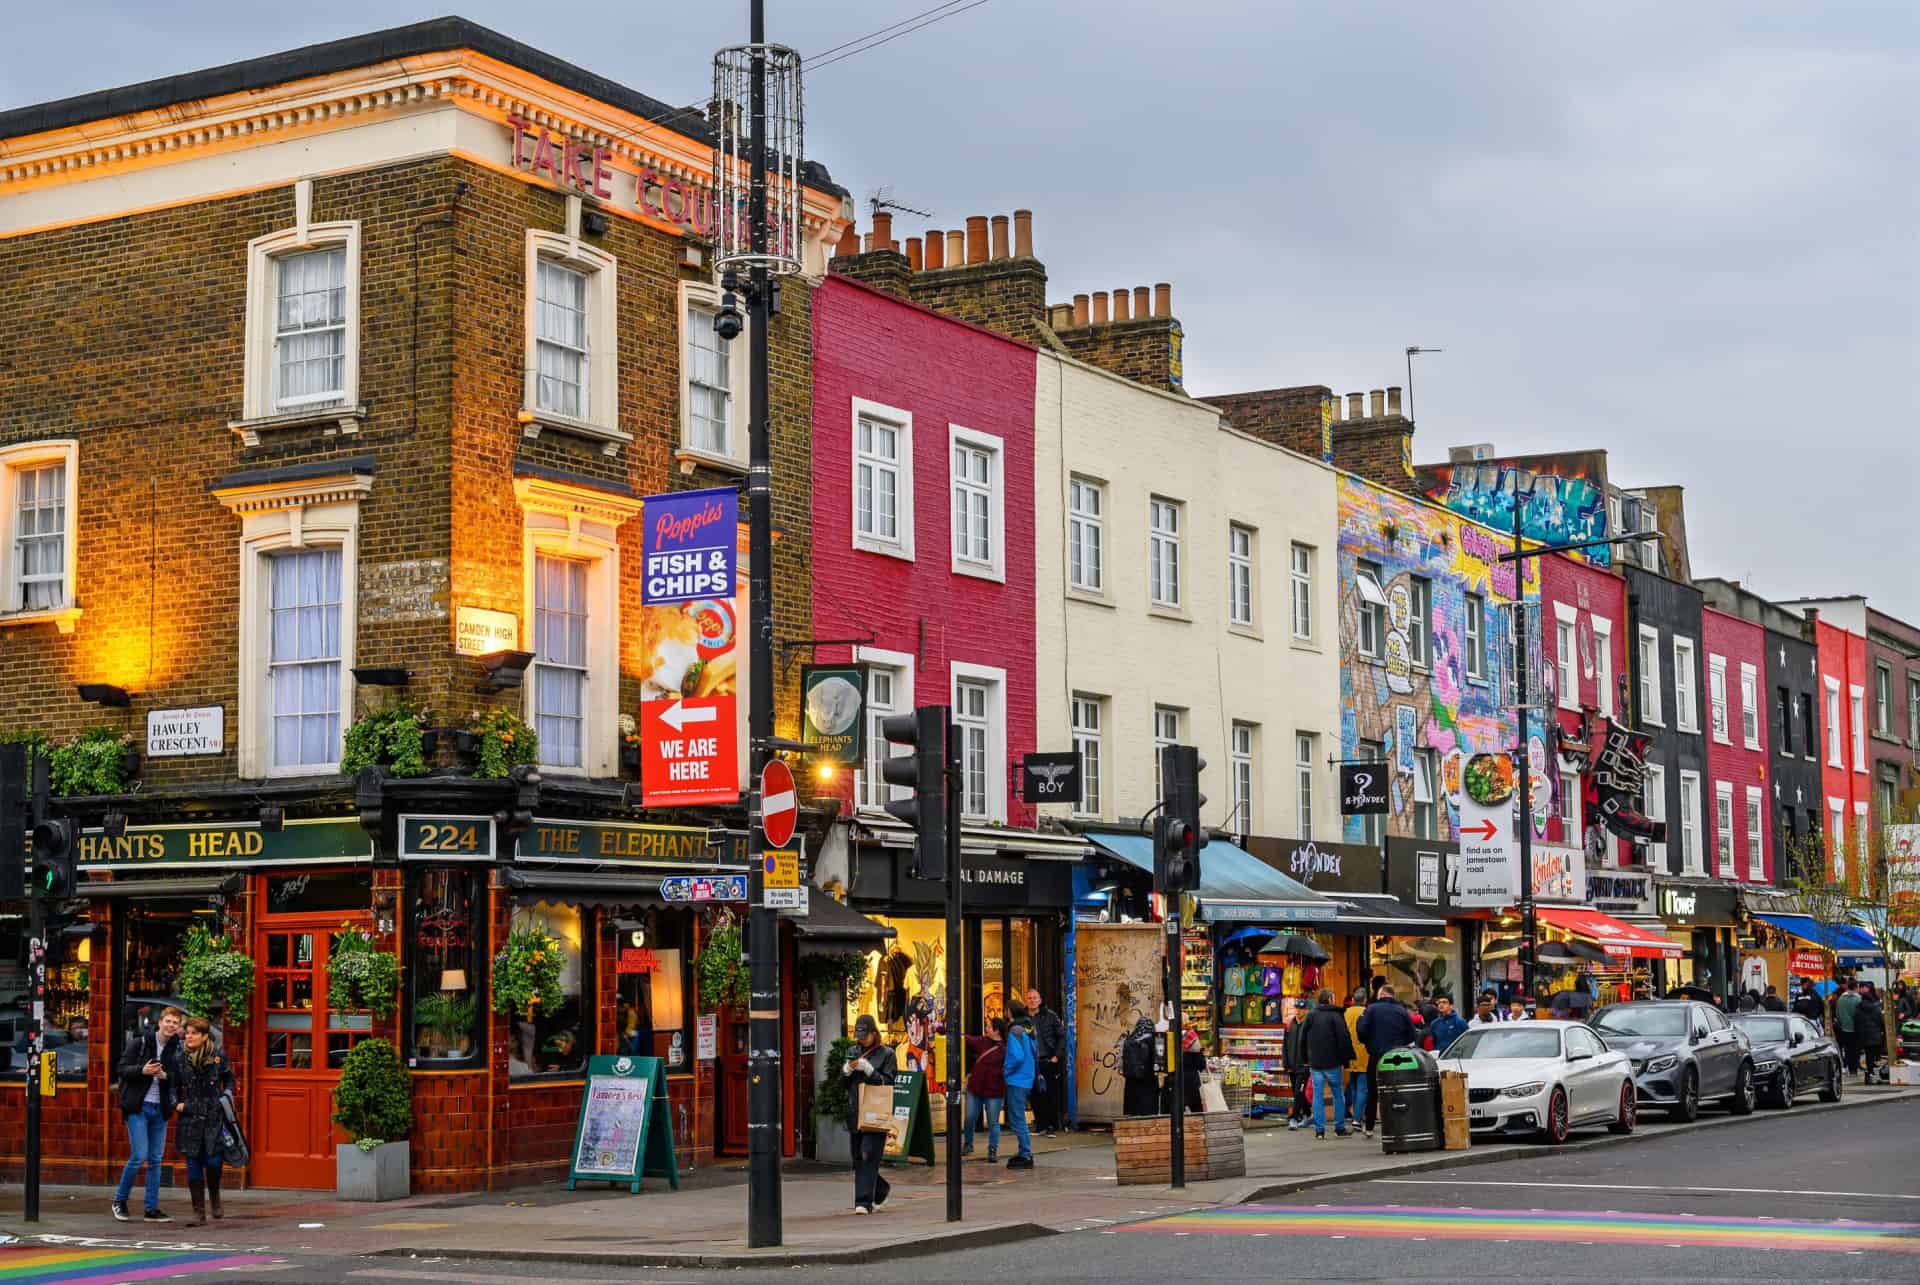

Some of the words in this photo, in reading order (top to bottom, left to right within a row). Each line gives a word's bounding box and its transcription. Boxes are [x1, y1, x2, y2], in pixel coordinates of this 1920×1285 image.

[507, 114, 612, 200] TAKE
[648, 553, 702, 576] FISH
[709, 550, 727, 571] &
[648, 572, 728, 597] CHIPS
[458, 622, 491, 638] CAMDEN
[494, 628, 513, 641] HIGH
[152, 722, 201, 737] HAWLEY
[150, 736, 208, 751] CRESCENT
[807, 735, 853, 744] ELEPHANTS
[820, 743, 842, 752] HEAD
[660, 739, 685, 759] WE
[687, 738, 717, 757] ARE
[669, 760, 709, 780] HERE
[1038, 782, 1065, 793] BOY
[188, 831, 264, 857] HEAD
[418, 824, 478, 850] 224
[536, 827, 580, 853] THE
[1466, 856, 1507, 865] jamestown
[1466, 865, 1484, 873] road
[979, 871, 1024, 884] DAMAGE
[1467, 887, 1507, 896] wagamama
